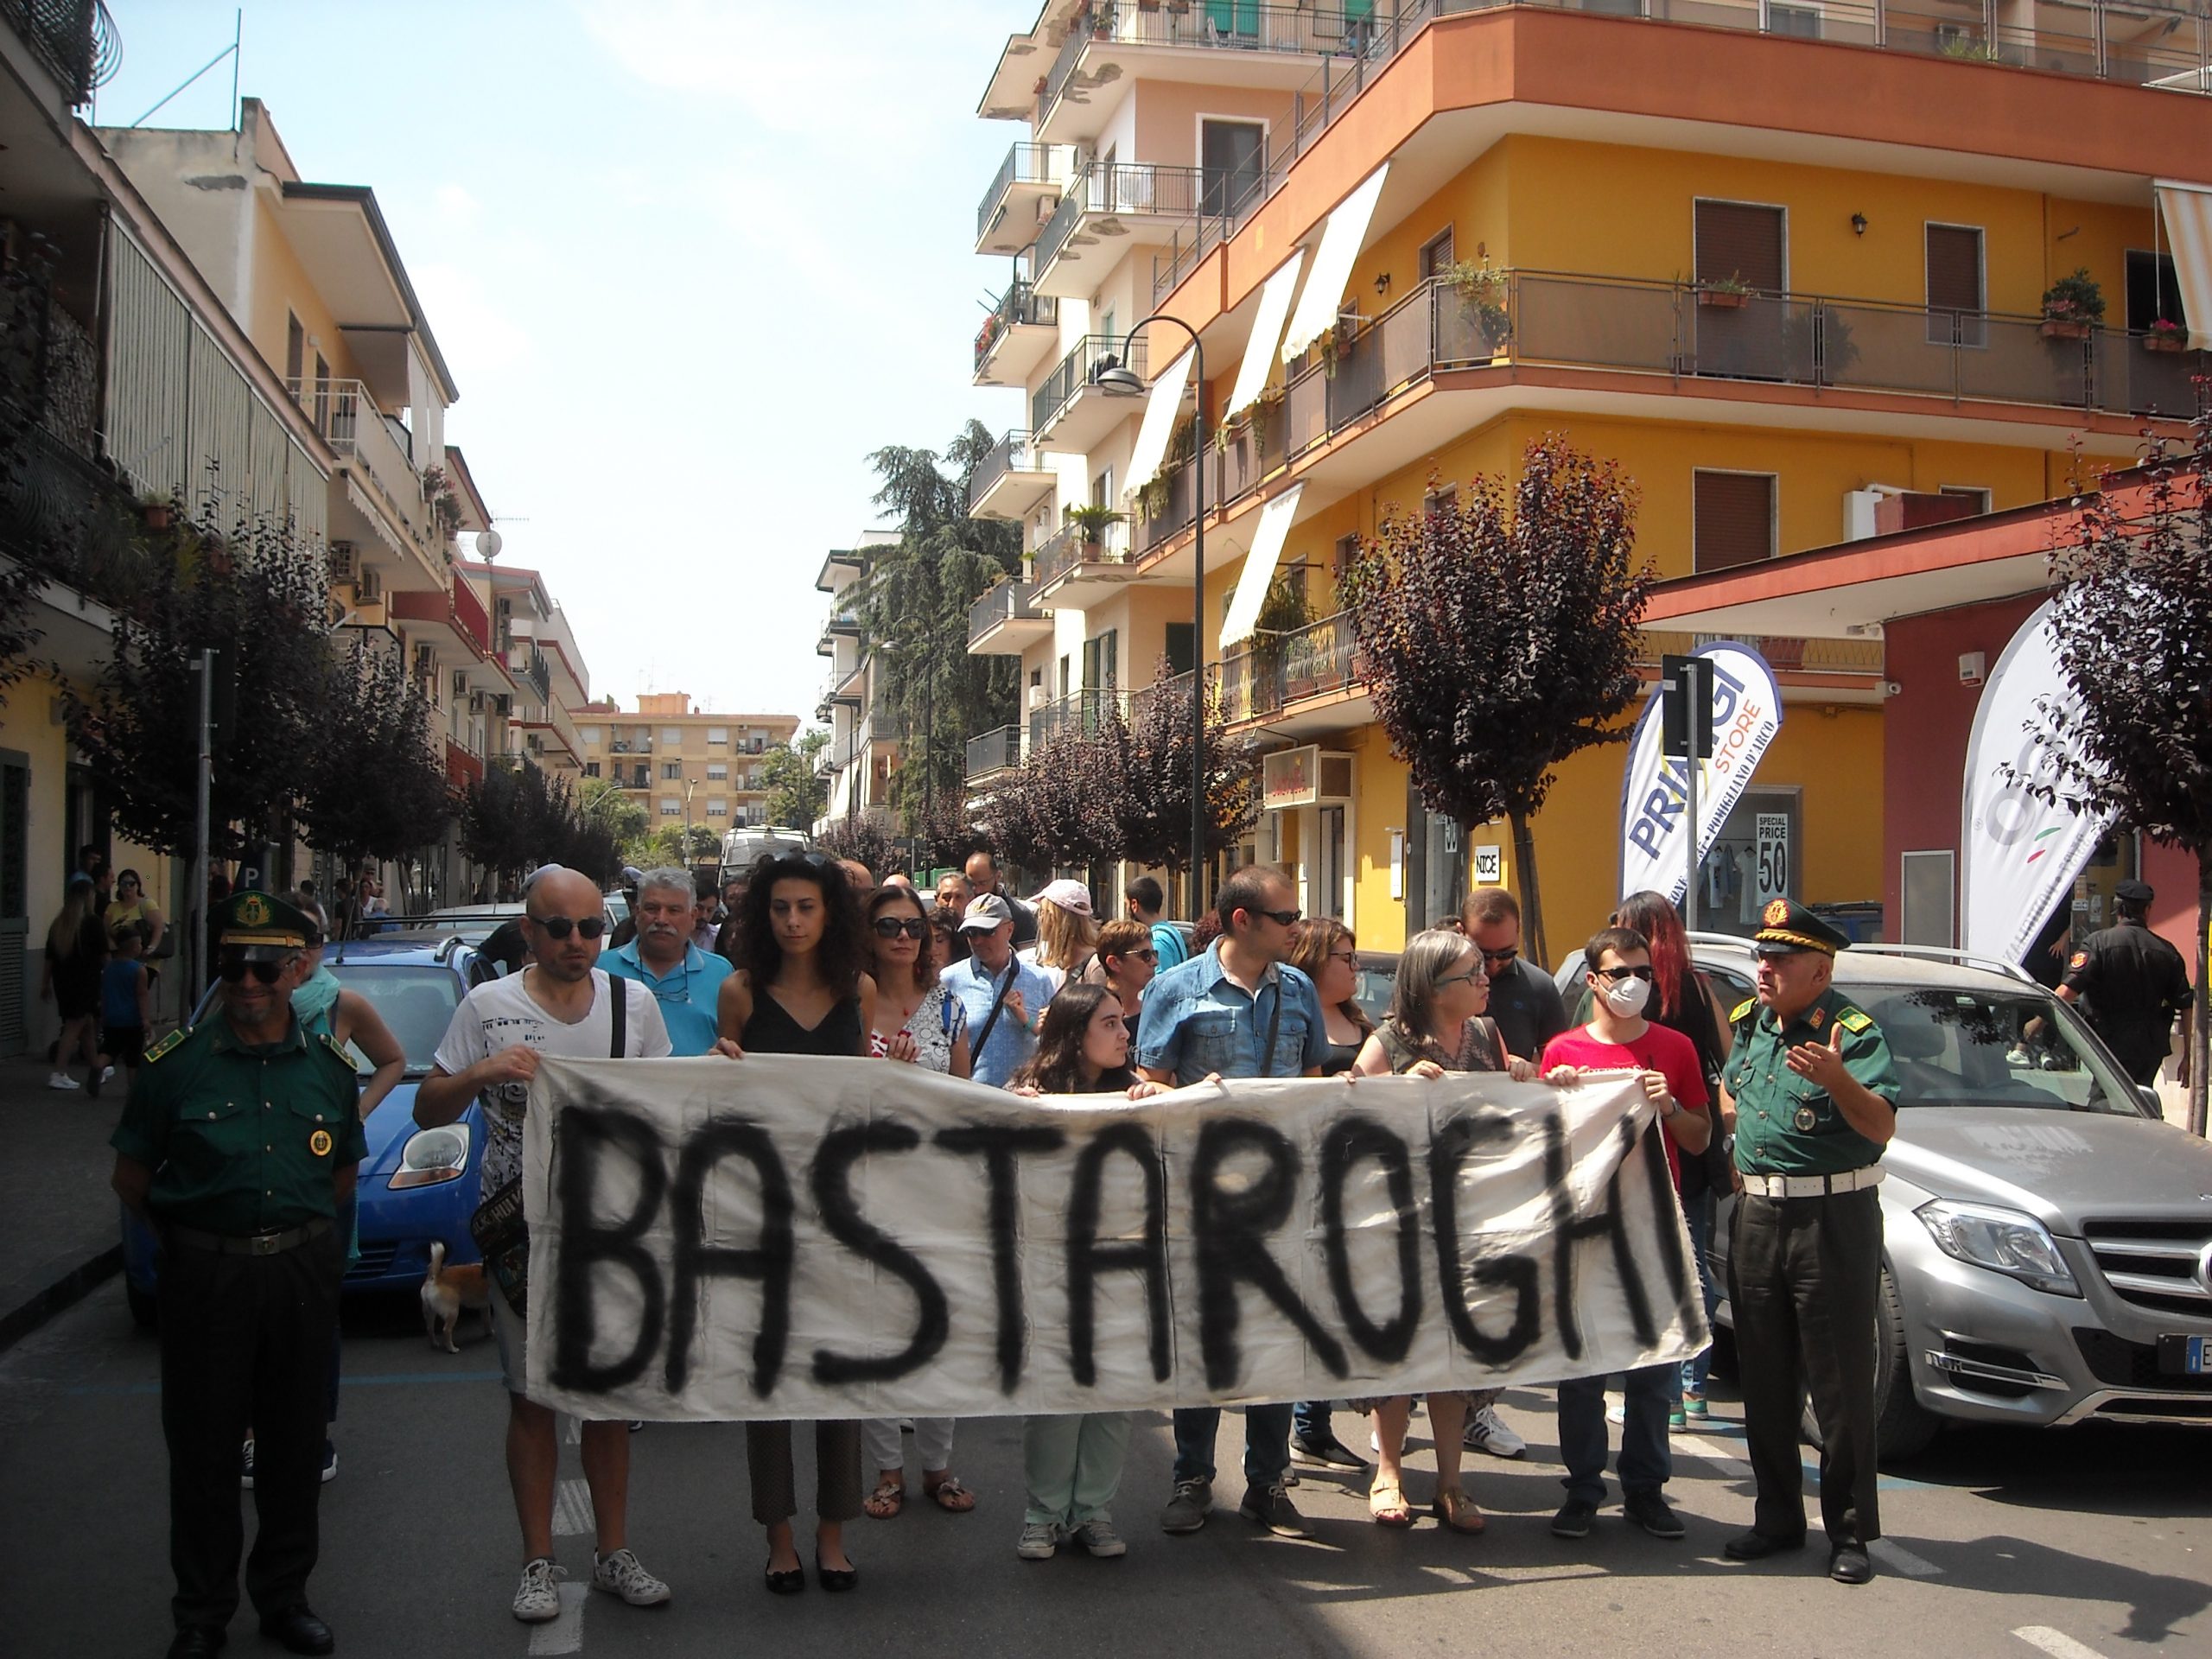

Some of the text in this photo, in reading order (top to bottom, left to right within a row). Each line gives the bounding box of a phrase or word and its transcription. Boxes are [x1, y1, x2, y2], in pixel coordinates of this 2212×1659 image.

[1715, 698, 1761, 773] STORE
[1707, 763, 1751, 836] POMIGLIANO
[1745, 720, 1776, 766] D'ARCO
[1759, 817, 1786, 826] SPECIAL
[1759, 827, 1786, 839] PRICE
[245, 868, 259, 888] P
